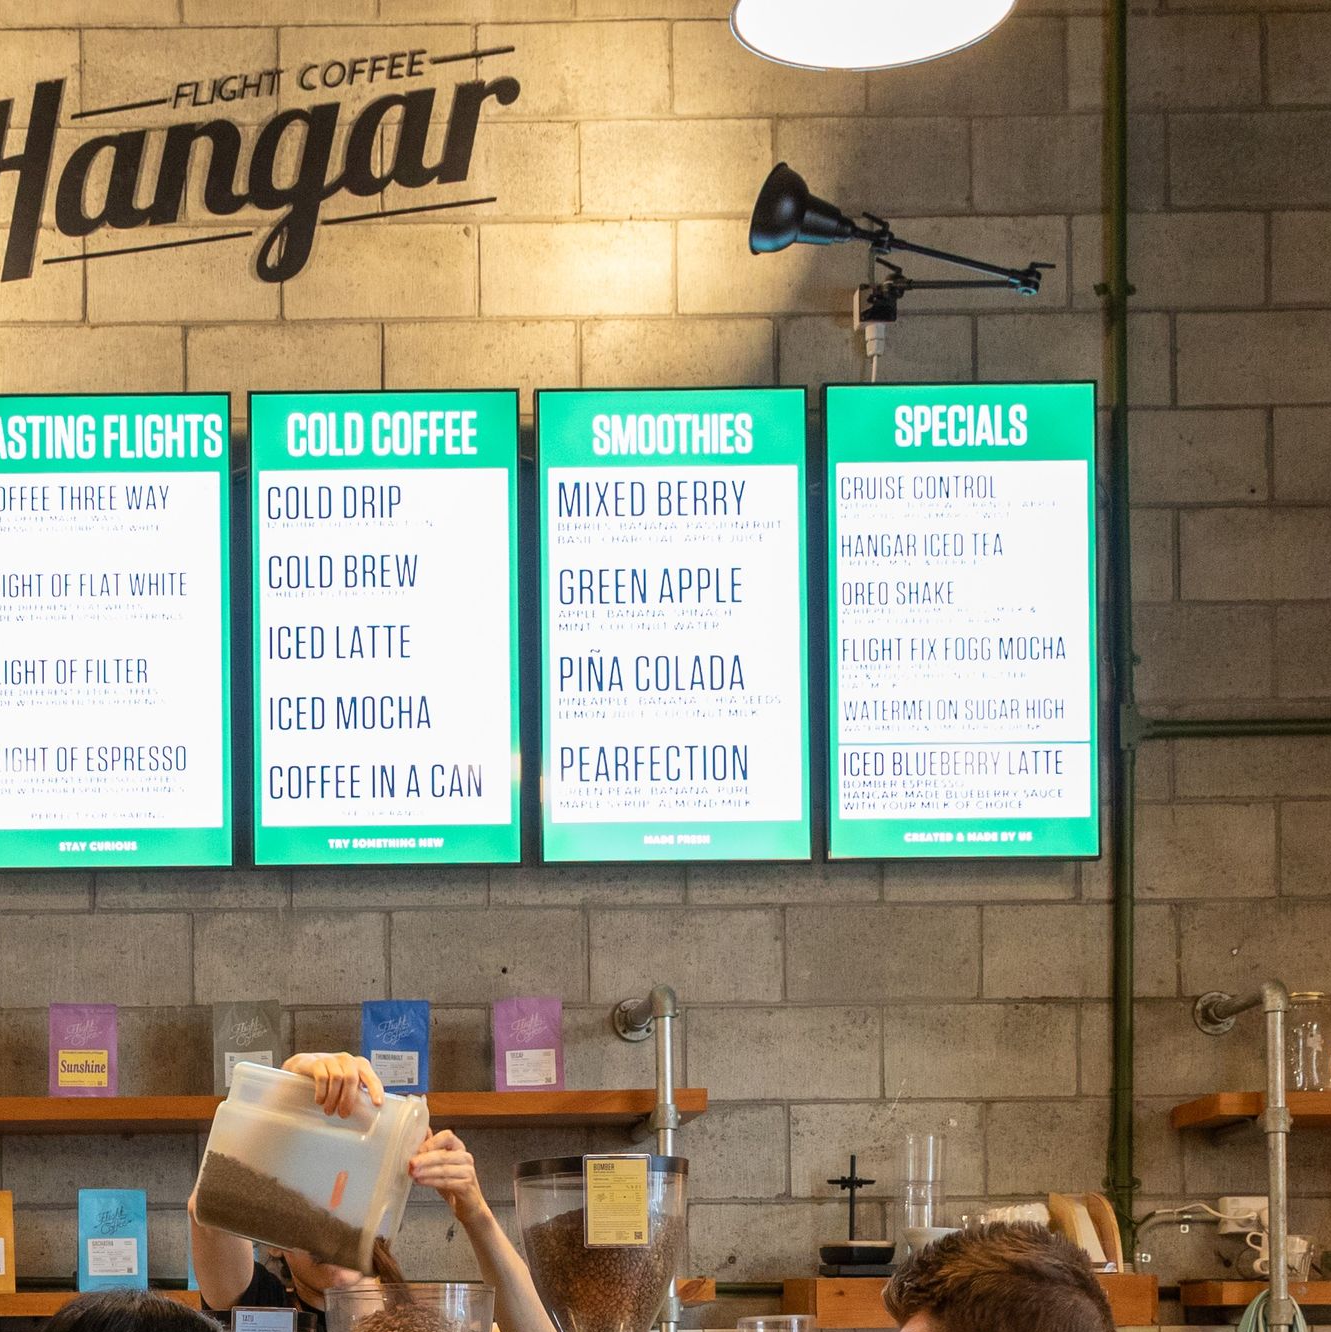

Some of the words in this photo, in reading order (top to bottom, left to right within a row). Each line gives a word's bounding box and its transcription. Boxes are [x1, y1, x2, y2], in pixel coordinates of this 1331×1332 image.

[172, 69, 283, 110] FLIGHT
[299, 49, 427, 92] COFFEE
[103, 414, 222, 459] FLIGHTS
[287, 411, 364, 457] COLD
[372, 410, 477, 456] COFFEE
[592, 413, 753, 456] SMOOTHIES
[895, 404, 1027, 447] SPECIALS
[59, 485, 117, 511] THREE
[126, 485, 169, 510] WAY
[268, 486, 332, 519] COLD
[343, 485, 401, 518] DRIP
[558, 481, 645, 517] MIXED
[658, 481, 745, 516] BERRY
[841, 476, 905, 500] CRUISE
[914, 475, 997, 499] CONTROL
[841, 534, 917, 557] HANGAR
[924, 534, 963, 556] ICED
[972, 533, 1003, 556] TEA
[51, 573, 71, 597] OF
[80, 573, 121, 597] FLAT
[129, 572, 187, 596] WHITE
[269, 555, 333, 588] COLD
[344, 554, 418, 588] BREW
[559, 568, 647, 604] GREEN
[659, 567, 742, 603] APPLE
[842, 582, 888, 605] OREO
[896, 581, 954, 605] SHAKE
[269, 626, 324, 659] ICED
[336, 625, 411, 658] LATTE
[842, 638, 903, 662] FLIGHT
[910, 638, 937, 661] FIX
[944, 637, 991, 661] FOGG
[999, 636, 1066, 660] MOCHA
[56, 659, 77, 684] OF
[86, 659, 148, 684] FILTER
[560, 649, 624, 691] PIÑA
[635, 655, 745, 691] COLADA
[270, 697, 325, 730] ICED
[336, 696, 431, 729] MOCHA
[844, 700, 958, 721] WATERMELON
[965, 699, 1019, 720] SUGAR
[1026, 699, 1064, 719] HIGH
[57, 747, 78, 772] OF
[86, 746, 187, 772] ESPRESSO
[560, 745, 748, 782] PEARFECTION
[843, 752, 884, 776] ICED
[893, 751, 1000, 776] BLUEBERRY
[1008, 750, 1063, 775] LATTE
[269, 765, 360, 799] COFFEE
[372, 765, 395, 798] IN
[406, 764, 420, 797] A
[431, 764, 482, 797] CAN
[59, 842, 86, 851] STAY
[89, 841, 137, 851] CURIOUS
[328, 839, 349, 848] TRY
[352, 838, 416, 848] SOMETHING
[419, 838, 444, 847] NEW
[60, 1060, 106, 1074] Sunshine
[593, 1163, 614, 1171] BOMBER
